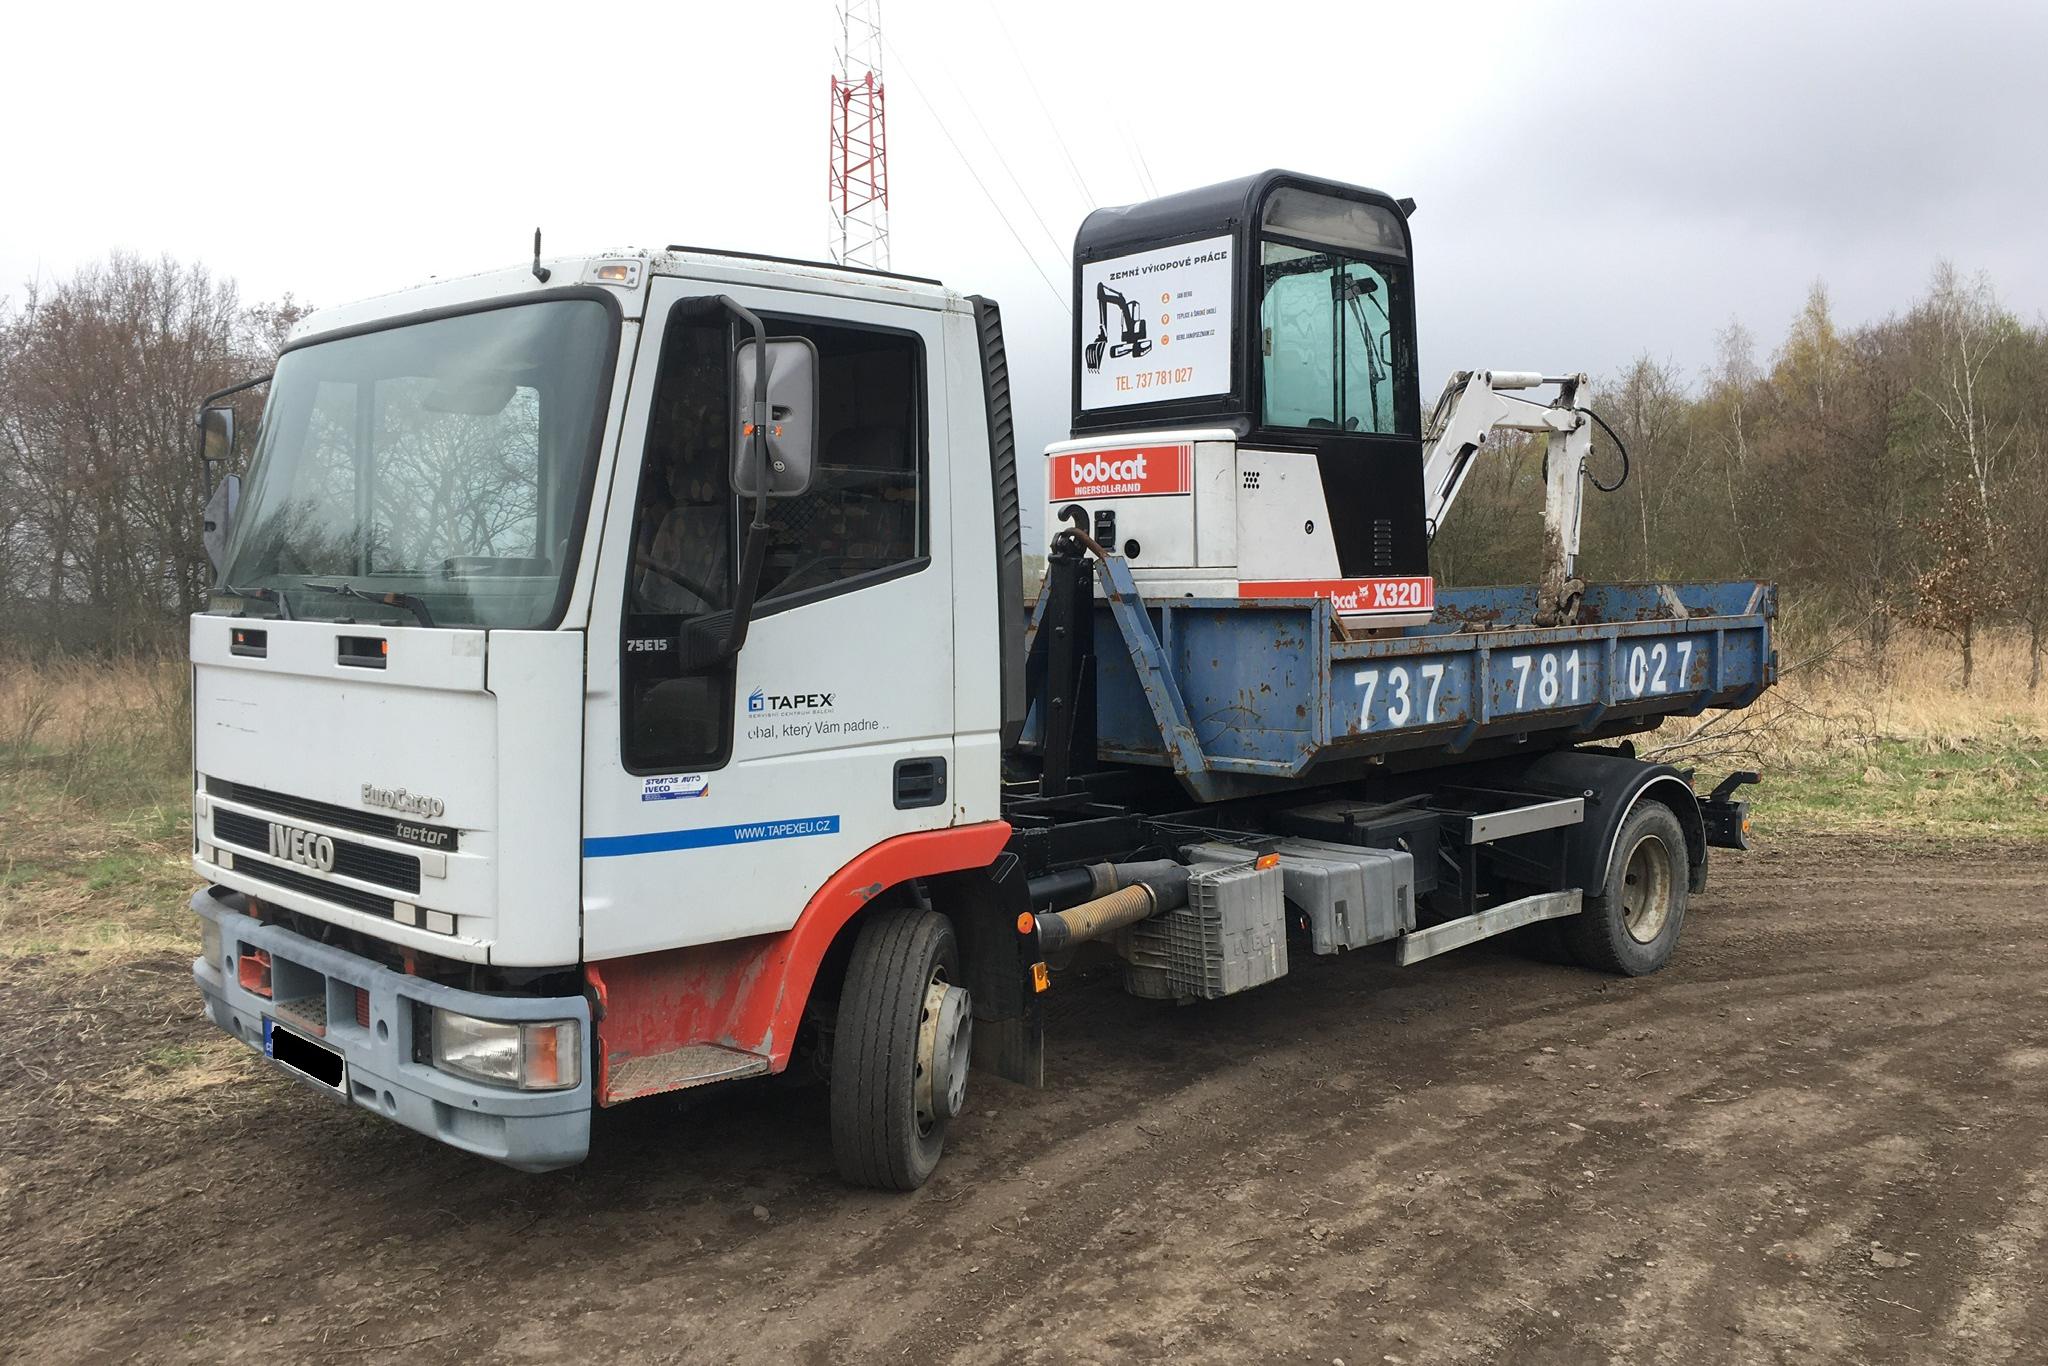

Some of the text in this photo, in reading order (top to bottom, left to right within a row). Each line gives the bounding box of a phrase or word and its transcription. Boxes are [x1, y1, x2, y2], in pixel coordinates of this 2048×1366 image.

[1110, 250, 1228, 280] ZEMNÍ VÝKOPOVÉ PRÁCE
[1116, 367, 1193, 391] TEL. 737 781 027
[1071, 453, 1147, 484] bobcat
[1373, 582, 1422, 607] X320
[627, 639, 668, 652] 75E15
[1354, 640, 1693, 731] 737 781 027
[767, 693, 833, 710] TAPEX
[782, 721, 813, 738] který
[814, 719, 841, 734] Vám
[361, 783, 446, 819] EuroCargo
[644, 785, 672, 793] IVECO
[396, 822, 449, 845] tector
[734, 820, 831, 840] WWW.TAPEXEU.CZ
[268, 822, 335, 873] IVECO
